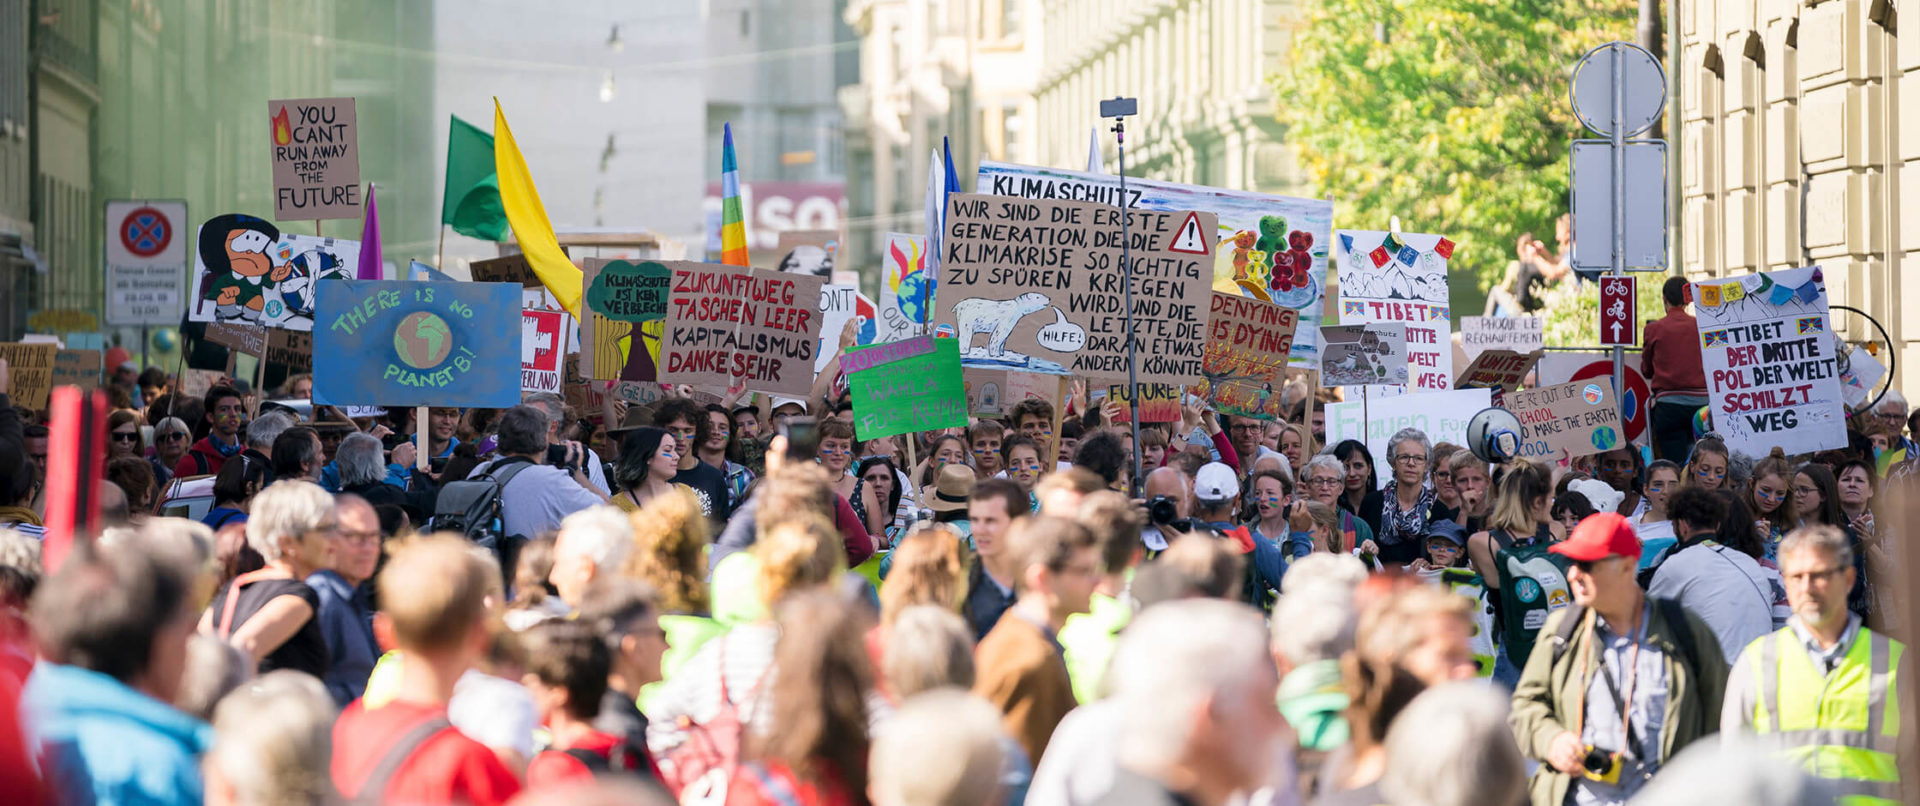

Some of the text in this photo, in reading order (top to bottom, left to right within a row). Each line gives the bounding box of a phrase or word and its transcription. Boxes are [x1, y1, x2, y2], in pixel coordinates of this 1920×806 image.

[297, 105, 336, 125] YOU
[293, 124, 348, 143] CAN'T
[276, 144, 348, 162] RUN AWAY
[294, 161, 328, 174] FROM
[298, 171, 324, 184] THE
[278, 184, 360, 211] FUTURE
[993, 174, 1143, 208] KLIMASCHUTZ
[953, 200, 1171, 232] WIR SIND DIE ERSTE
[951, 222, 1161, 252] GENERATION, DIE DIE
[949, 243, 1200, 281] KLIMAKRISE SO RICHTIG
[605, 273, 671, 288] KLIMASCHUTZ
[947, 267, 1185, 299] ZU SPÜREN KRIEGEN
[616, 288, 632, 301] IST
[330, 287, 473, 335] THERE IS NO
[673, 297, 811, 334] TASCHEN LEER
[1070, 293, 1124, 315] WIRD,
[1167, 303, 1197, 321] DIE
[1210, 293, 1294, 327] DENYING
[1368, 301, 1428, 322] TIBET
[1090, 315, 1204, 340] LETZTE, DIE
[1524, 318, 1538, 329] LE
[1727, 320, 1784, 344] TIBET
[287, 334, 299, 348] IS
[671, 326, 811, 360] KAPITALISMUS
[1043, 331, 1082, 344] HILFE!
[1088, 335, 1205, 358] DARAN ETWAS
[1213, 319, 1293, 355] IS DYING
[1071, 353, 1202, 376] ÄNDERN KÖNNTE
[1479, 354, 1529, 371] UNITE
[1726, 337, 1821, 368] DER DRITTE
[383, 363, 454, 387] PLANET
[667, 349, 783, 382] DANKE SEHR
[1713, 358, 1836, 393] POL DER WELT
[620, 382, 657, 403] GELD
[1543, 388, 1559, 404] OUT
[1565, 384, 1576, 398] OF
[912, 398, 966, 427] KLIMA
[1333, 401, 1429, 443] Frauen
[1513, 407, 1557, 425] CHOOL
[1534, 420, 1562, 437] MAKE
[1564, 415, 1581, 430] THE
[1584, 407, 1617, 426] EARTH
[1745, 409, 1798, 433] WEG
